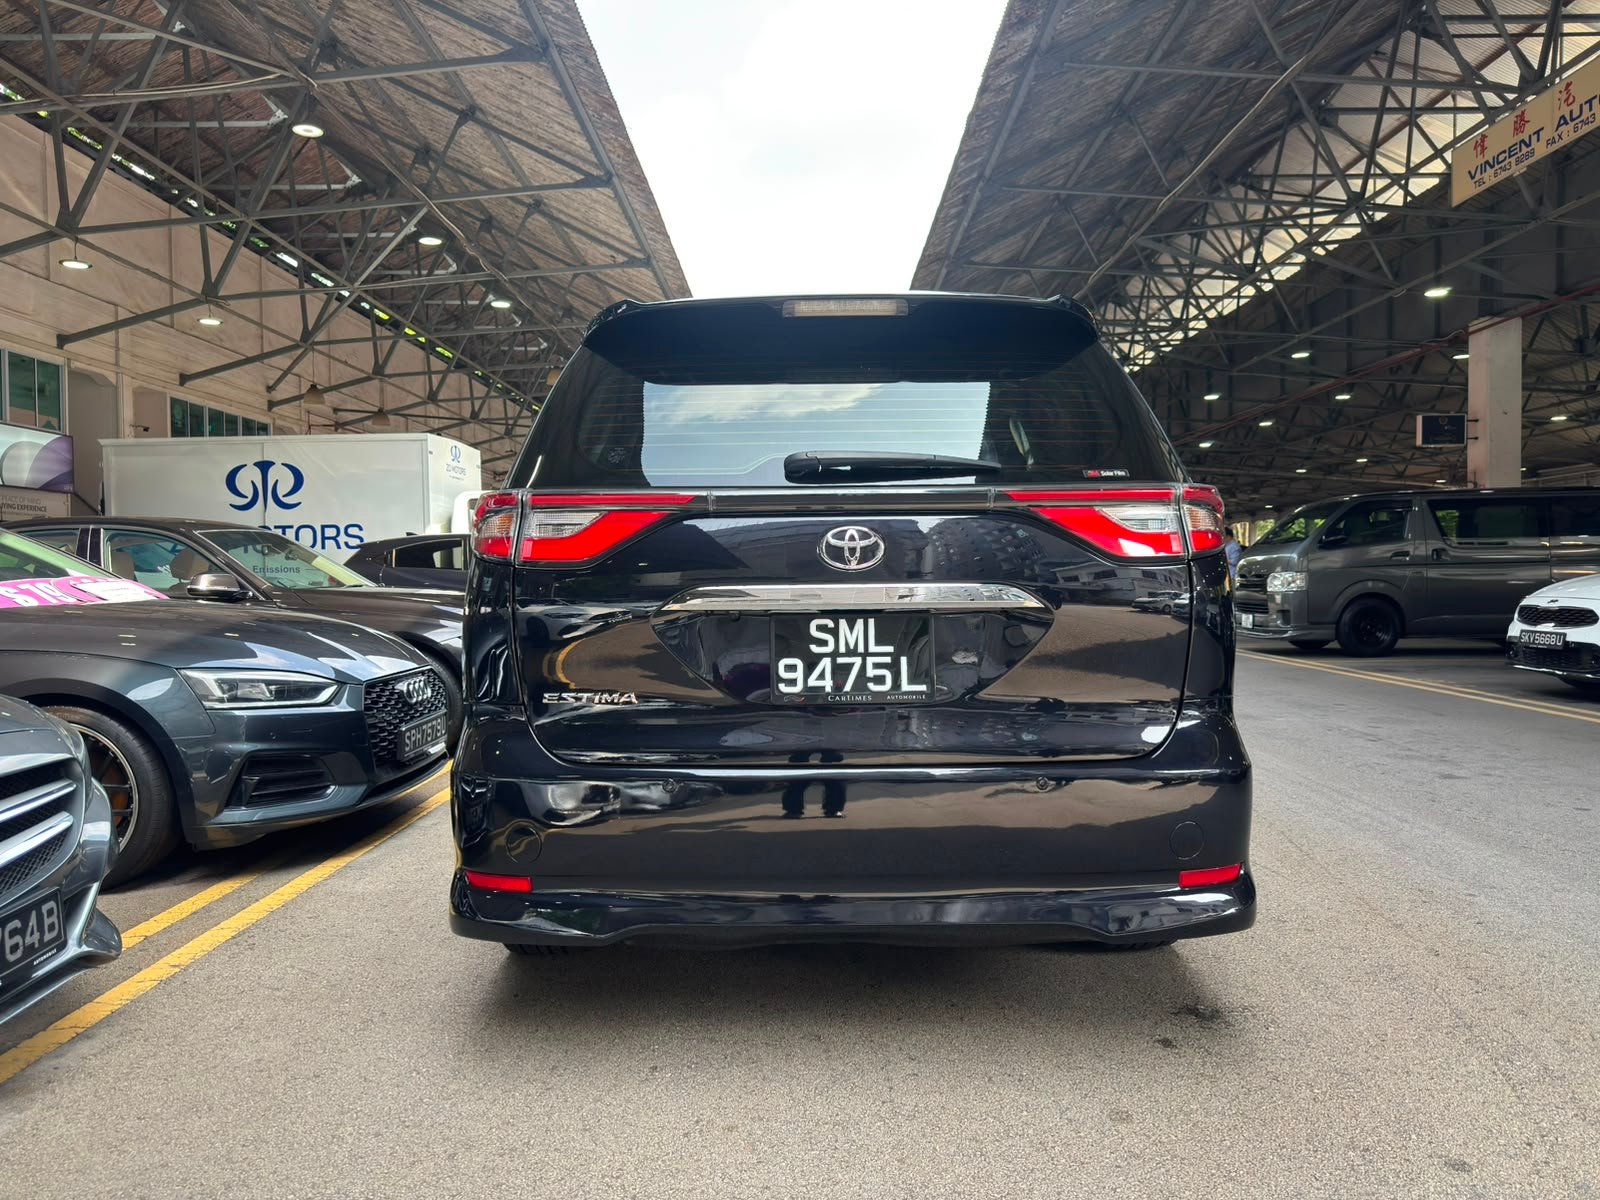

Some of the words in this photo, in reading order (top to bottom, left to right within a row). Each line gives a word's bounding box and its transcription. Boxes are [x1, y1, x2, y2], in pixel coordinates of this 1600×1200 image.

[1467, 126, 1545, 181] VINCENT
[1555, 94, 1600, 132] AUT
[1474, 178, 1486, 189] TEL
[1493, 161, 1512, 178] 6743
[1546, 131, 1563, 149] FAX
[1573, 112, 1596, 134] 6743
[256, 523, 365, 550] TORS
[808, 617, 895, 653] SML
[1520, 632, 1564, 646] SKV5668U
[777, 656, 927, 694] 9475L
[542, 692, 638, 704] ESTIMA
[404, 716, 447, 752] SPH7579U
[0, 901, 59, 963] 64B
[33, 948, 57, 966] AUTOMOBILE
